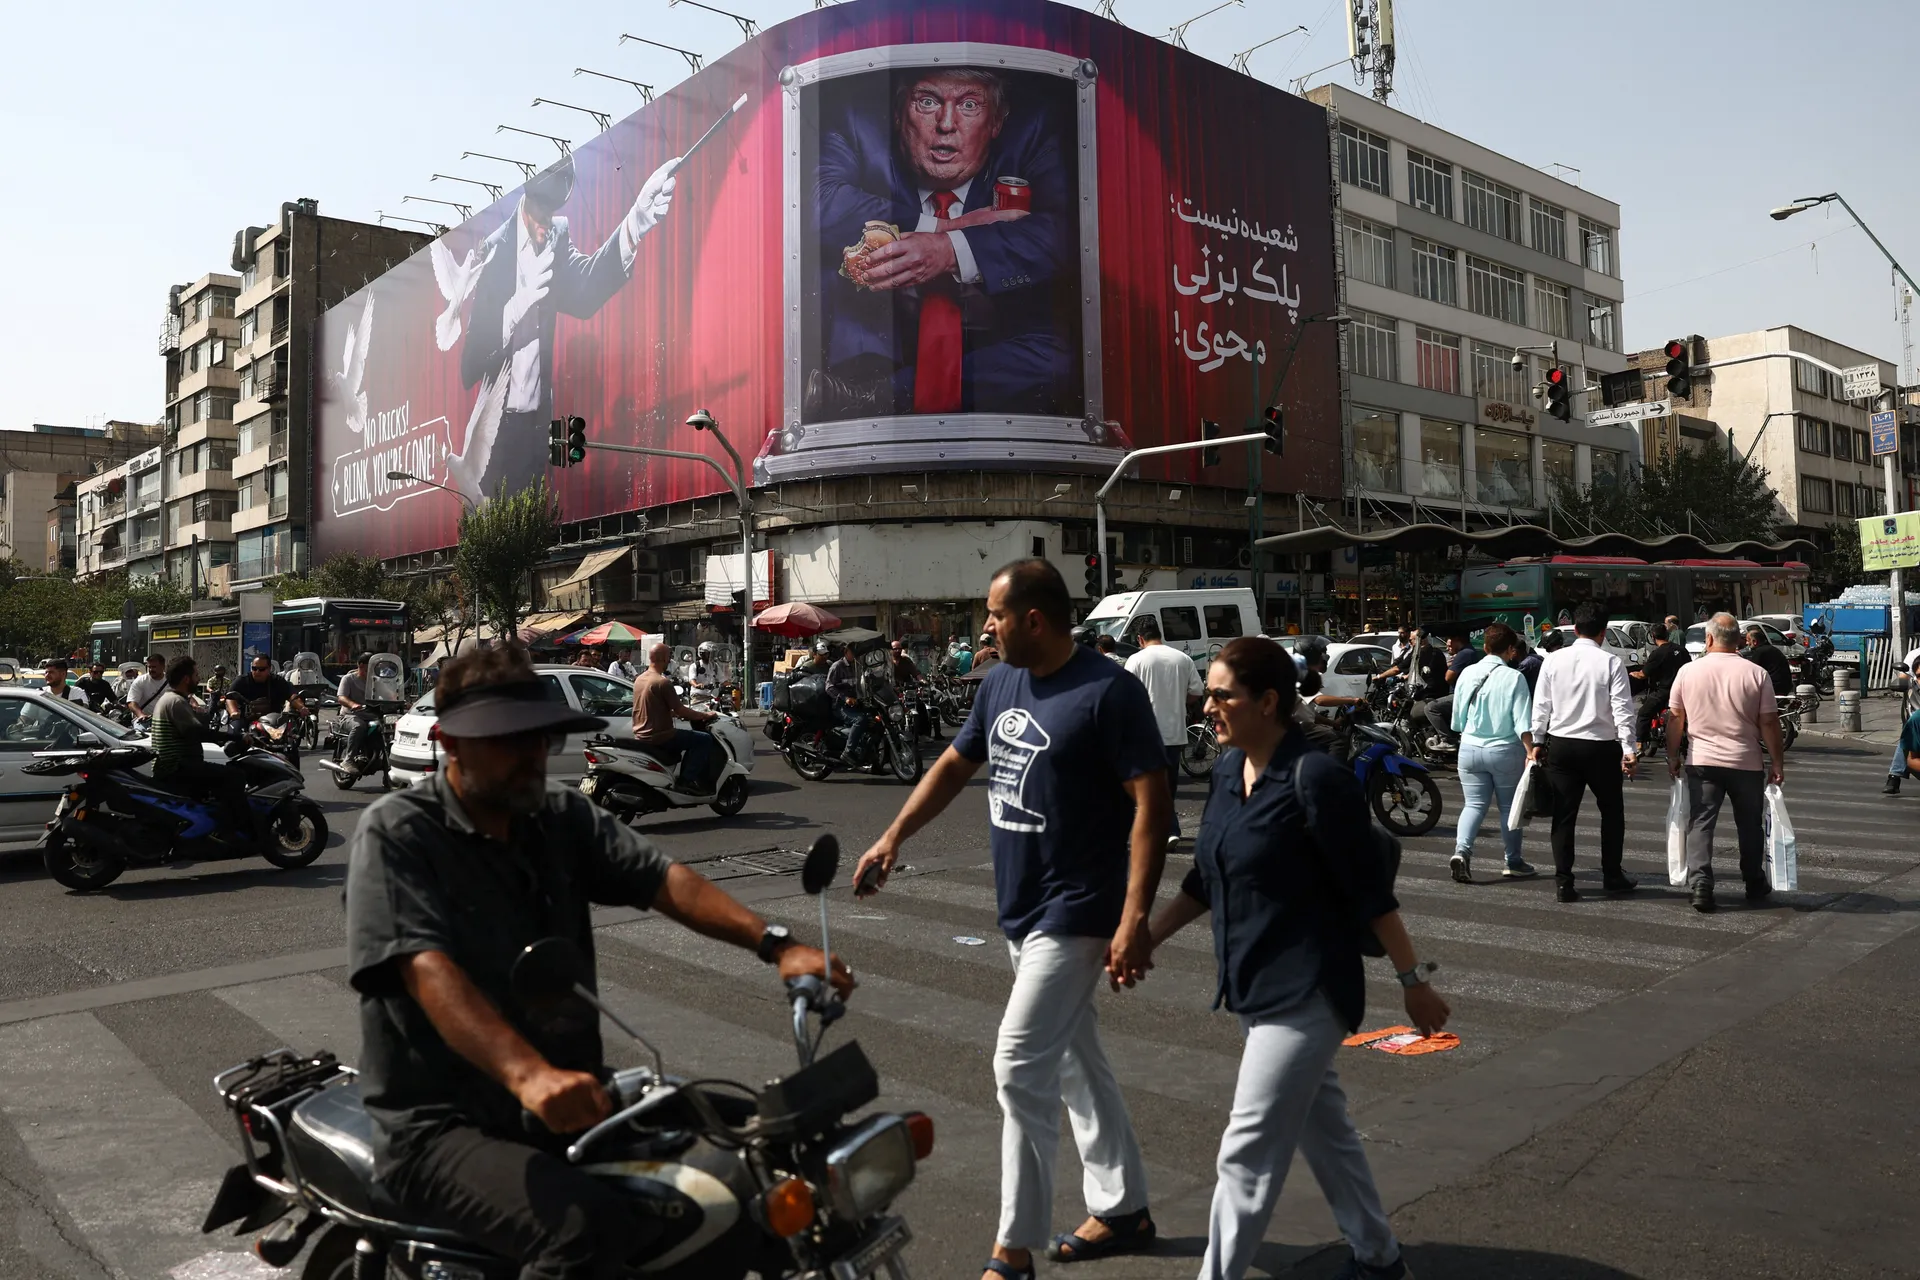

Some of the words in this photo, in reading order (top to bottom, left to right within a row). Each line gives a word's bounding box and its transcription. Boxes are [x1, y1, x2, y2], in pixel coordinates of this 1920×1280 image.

[1241, 218, 1298, 252] شعبده
[1173, 244, 1238, 306] بزنی
[1242, 257, 1301, 324] پلک
[1174, 310, 1267, 373] محوی!
[364, 416, 376, 450] NO
[378, 400, 409, 442] TRICKS!
[1589, 413, 1613, 424] اسلامی
[1614, 409, 1640, 419] جمهوری
[344, 457, 371, 505] BLINK,
[373, 446, 402, 496] YOU'RE
[405, 433, 436, 487] GONE!
[1211, 571, 1238, 588] کوه
